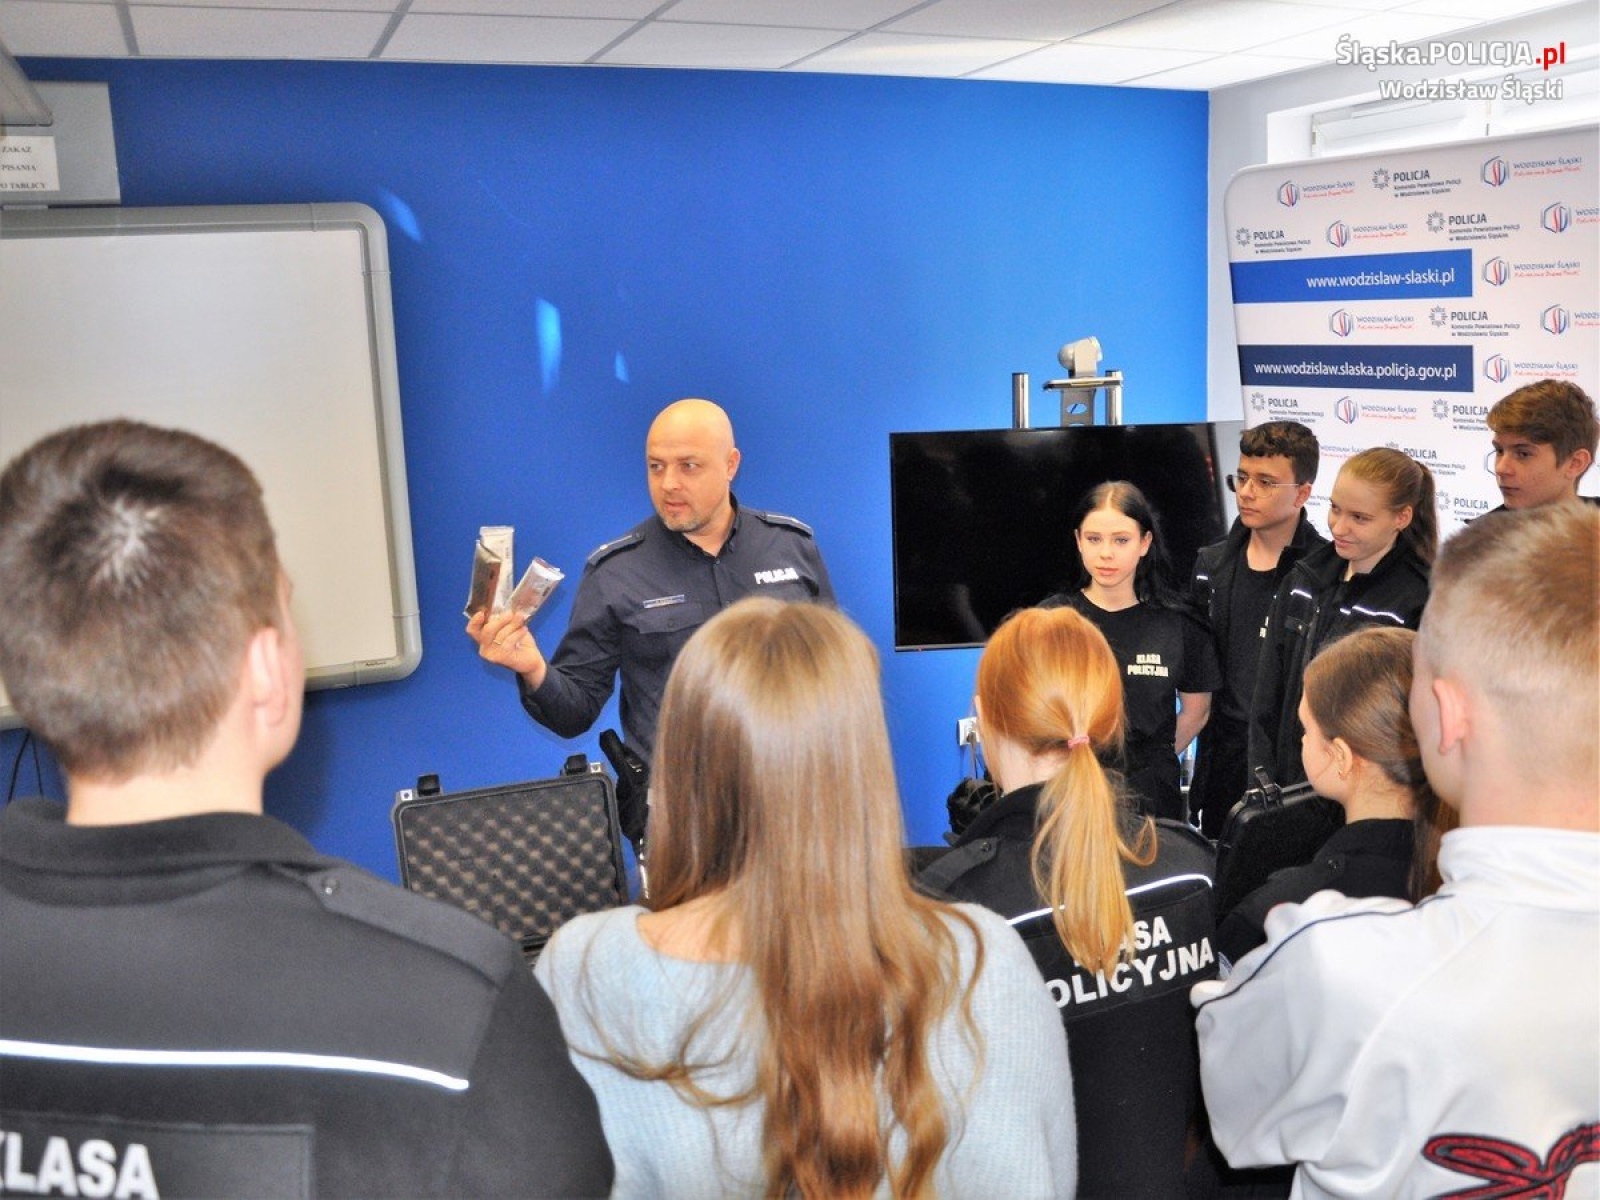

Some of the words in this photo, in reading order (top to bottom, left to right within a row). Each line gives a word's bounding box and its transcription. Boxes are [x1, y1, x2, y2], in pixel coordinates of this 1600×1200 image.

[1393, 170, 1430, 181] POLICJA
[1449, 213, 1487, 225] POLICJA
[1253, 230, 1285, 240] POLICJA
[1306, 268, 1455, 288] www.wodzislaw-slaski.pl
[1451, 311, 1488, 321] POLICJA
[1254, 361, 1457, 381] www.wodzislaw.slaska.policja.gov.pl
[1268, 398, 1299, 408] POLICJA
[1453, 404, 1489, 415] POLICJA
[1403, 447, 1437, 460] POLICJA
[1454, 498, 1489, 509] POLICJA
[754, 567, 799, 585] POLICJA
[1136, 653, 1161, 665] KLASA
[1127, 664, 1169, 677] POLICYJNA
[1045, 937, 1215, 1009] OLICYJNA
[0, 1131, 160, 1200] LASA
